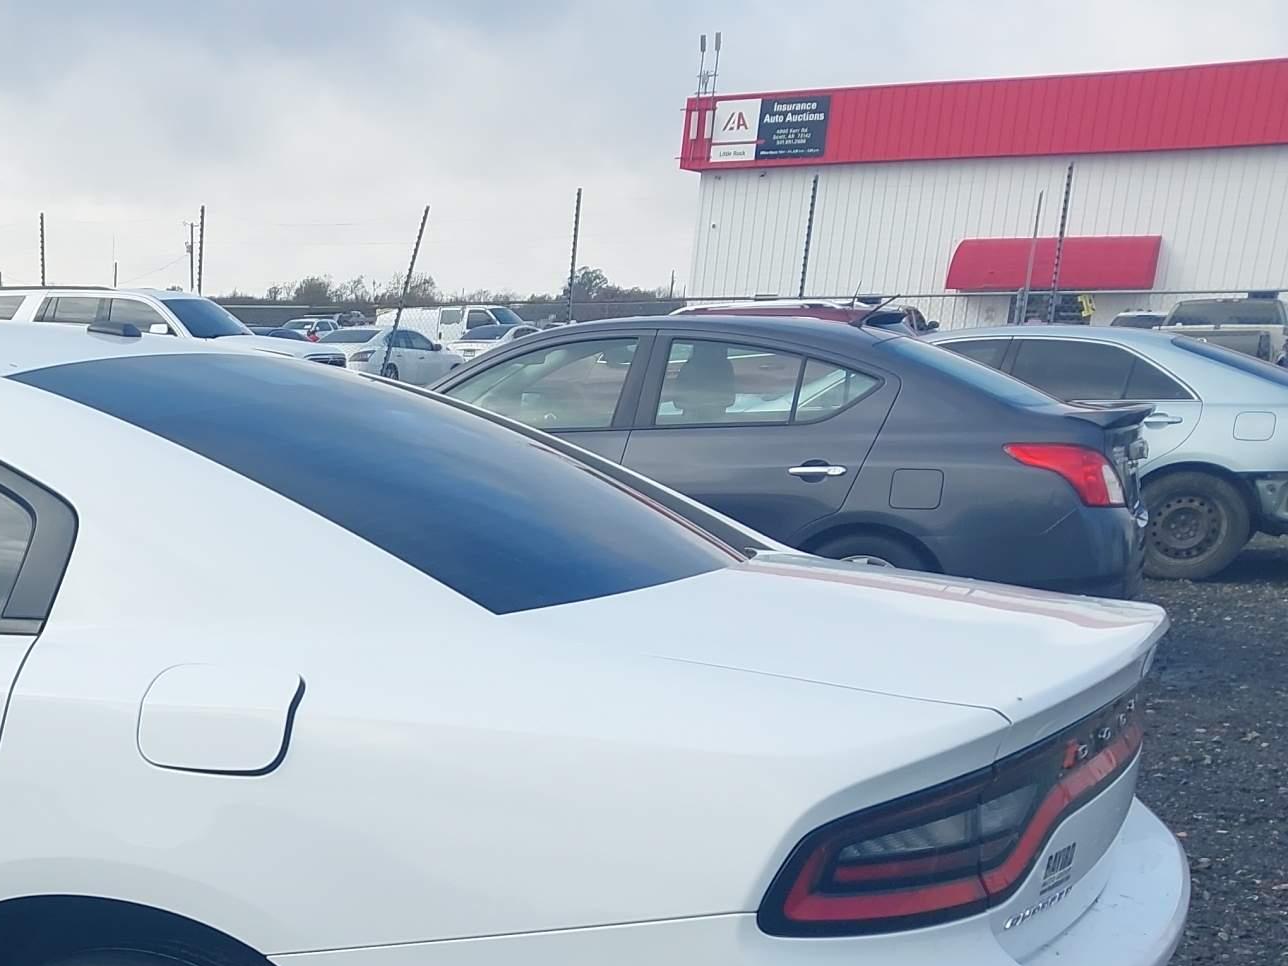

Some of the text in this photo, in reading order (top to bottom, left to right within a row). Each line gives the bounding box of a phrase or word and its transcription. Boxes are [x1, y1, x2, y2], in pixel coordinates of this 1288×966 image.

[774, 101, 817, 112] Insurance
[763, 112, 825, 123] Auto Auctions
[733, 149, 746, 157] Rock
